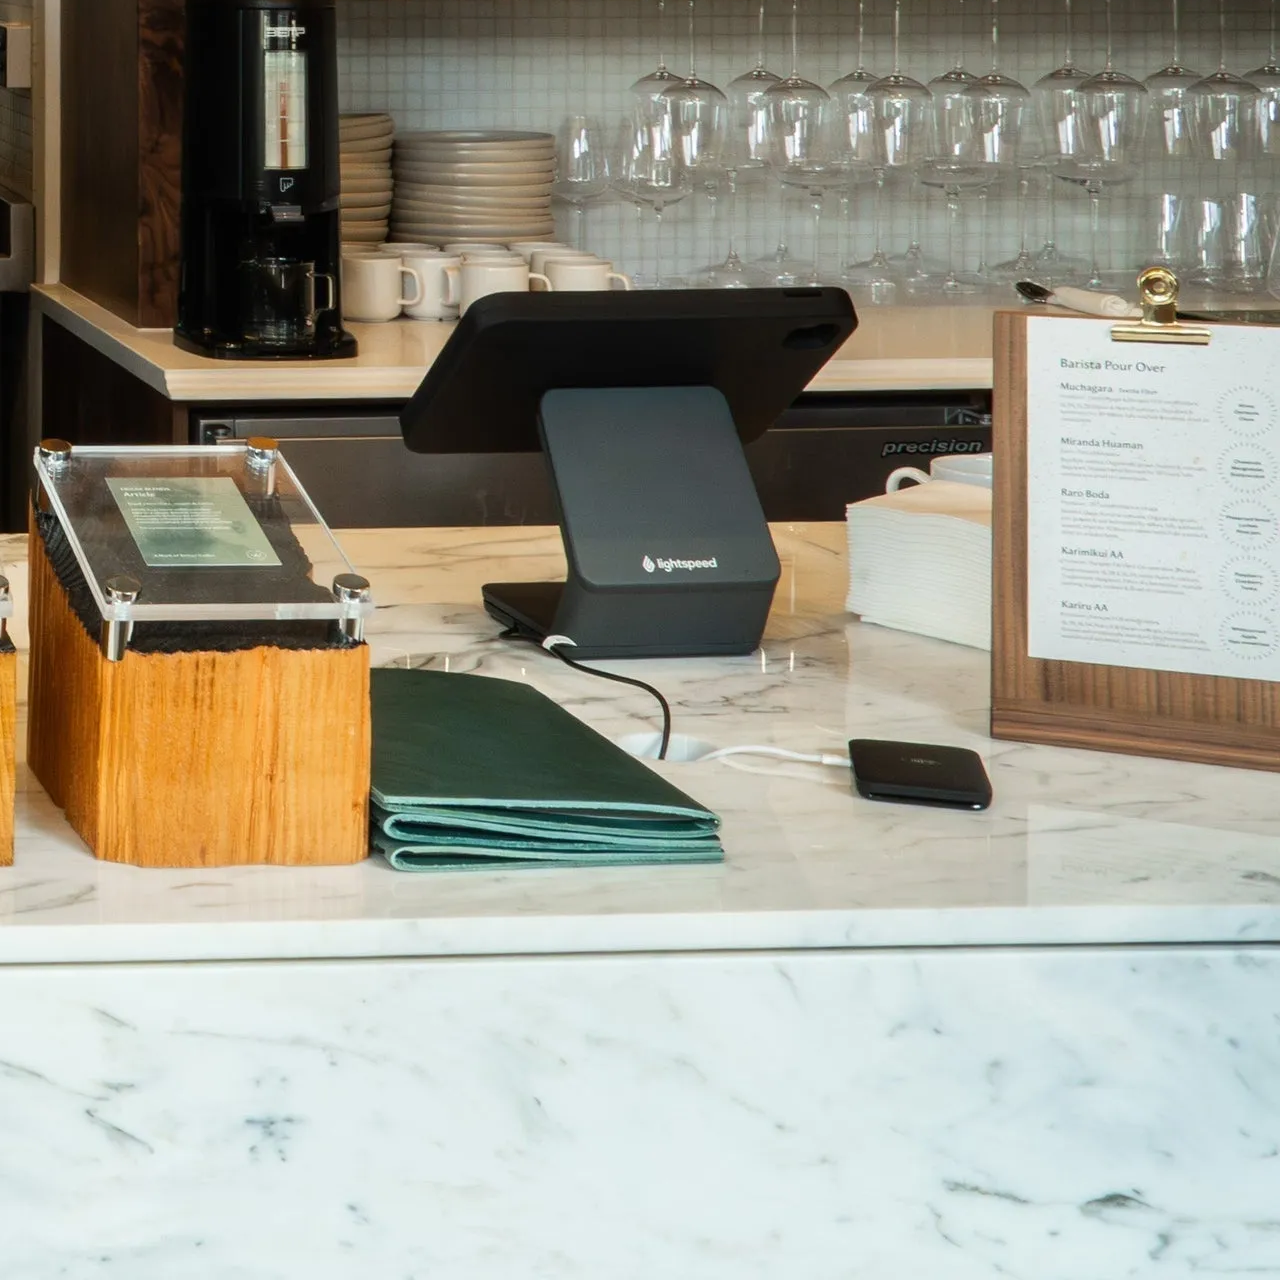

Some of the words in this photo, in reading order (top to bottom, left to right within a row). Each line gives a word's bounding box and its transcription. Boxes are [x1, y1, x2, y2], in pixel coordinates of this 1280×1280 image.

[1060, 358, 1102, 370] Barista
[1104, 360, 1133, 371] Pour
[1135, 361, 1167, 373] Over
[1060, 382, 1113, 393] Muchagara
[881, 439, 983, 457] precision
[1060, 437, 1101, 448] Miranda
[1102, 439, 1144, 450] Huaman
[1060, 488, 1084, 498] Raro
[1085, 489, 1110, 499] Boda
[1109, 550, 1124, 559] AA
[656, 557, 718, 572] lightspeed
[1093, 603, 1109, 612] AA
